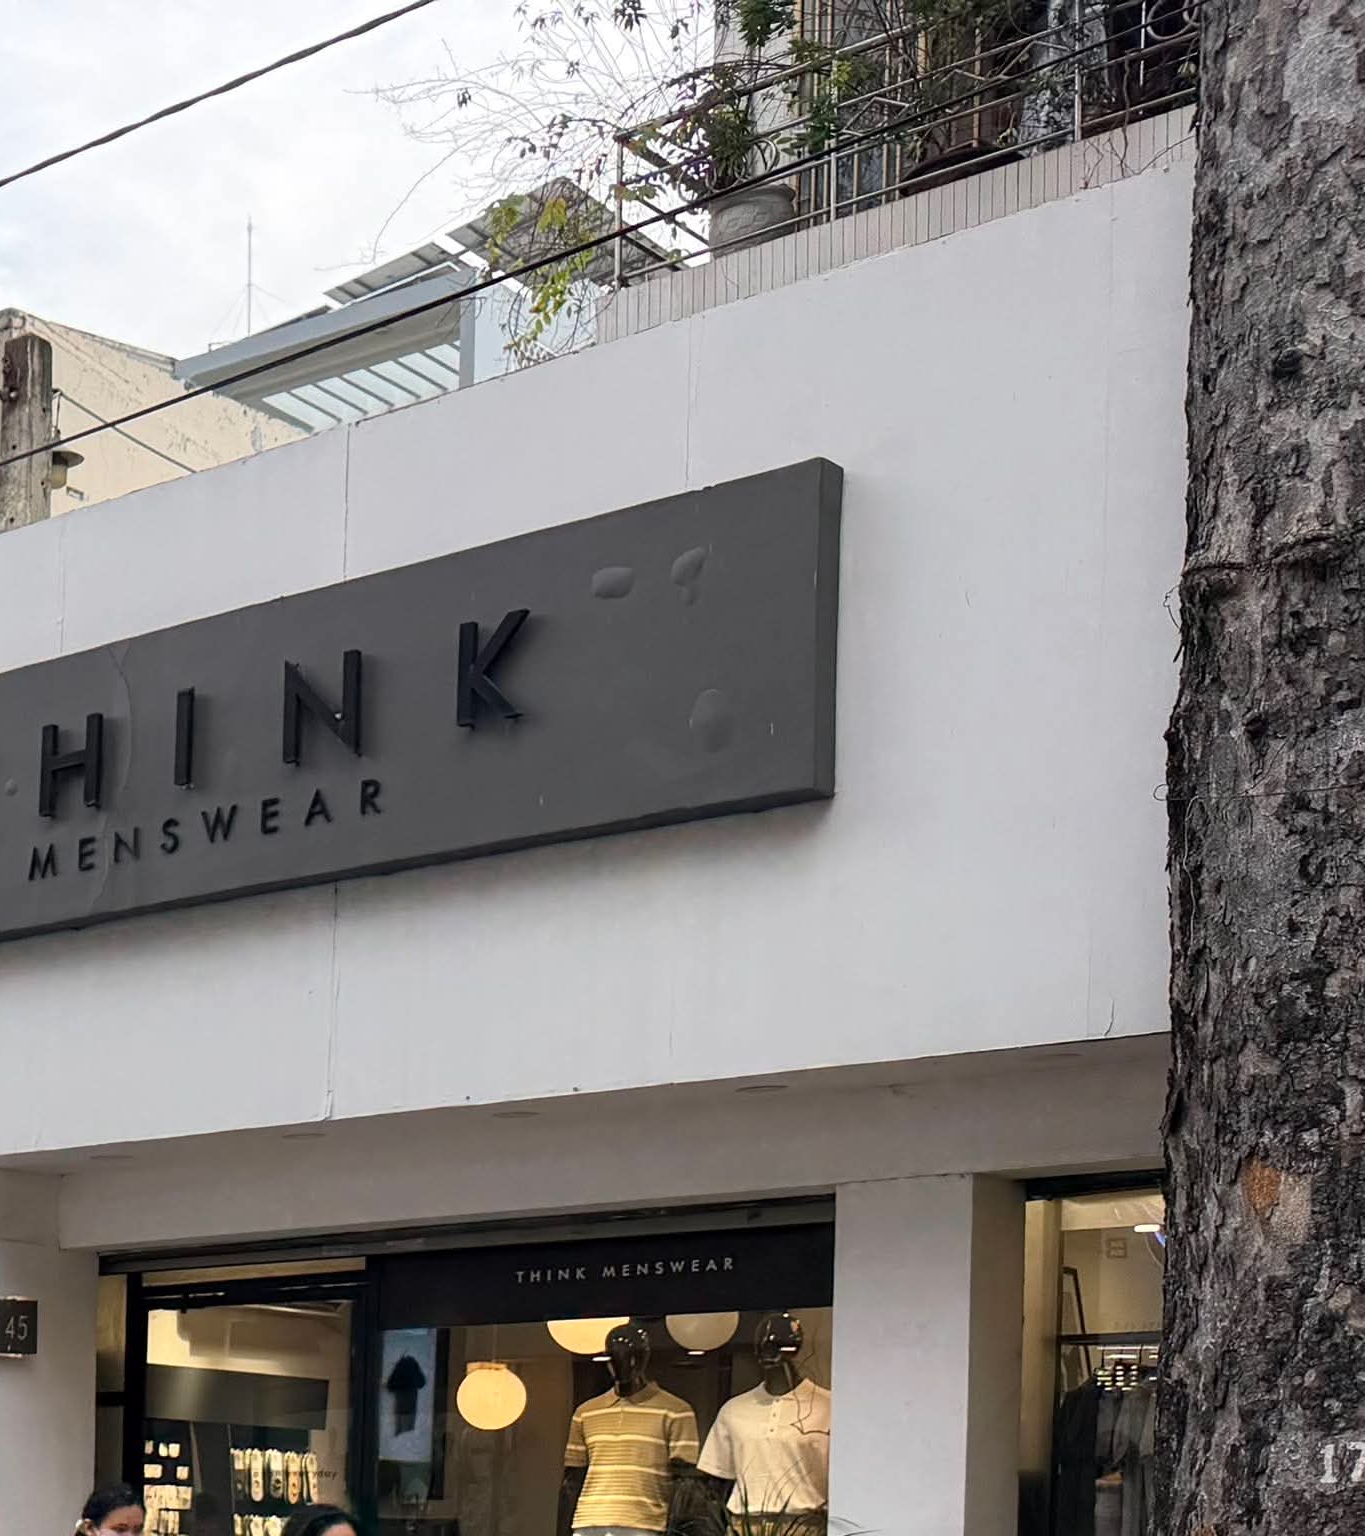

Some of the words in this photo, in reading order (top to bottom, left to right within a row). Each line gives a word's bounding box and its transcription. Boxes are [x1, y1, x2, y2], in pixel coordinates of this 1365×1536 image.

[28, 779, 381, 882] MENSWEAR
[516, 1266, 587, 1284] THINK
[601, 1257, 734, 1279] MENSWEAR
[5, 1314, 29, 1340] 45
